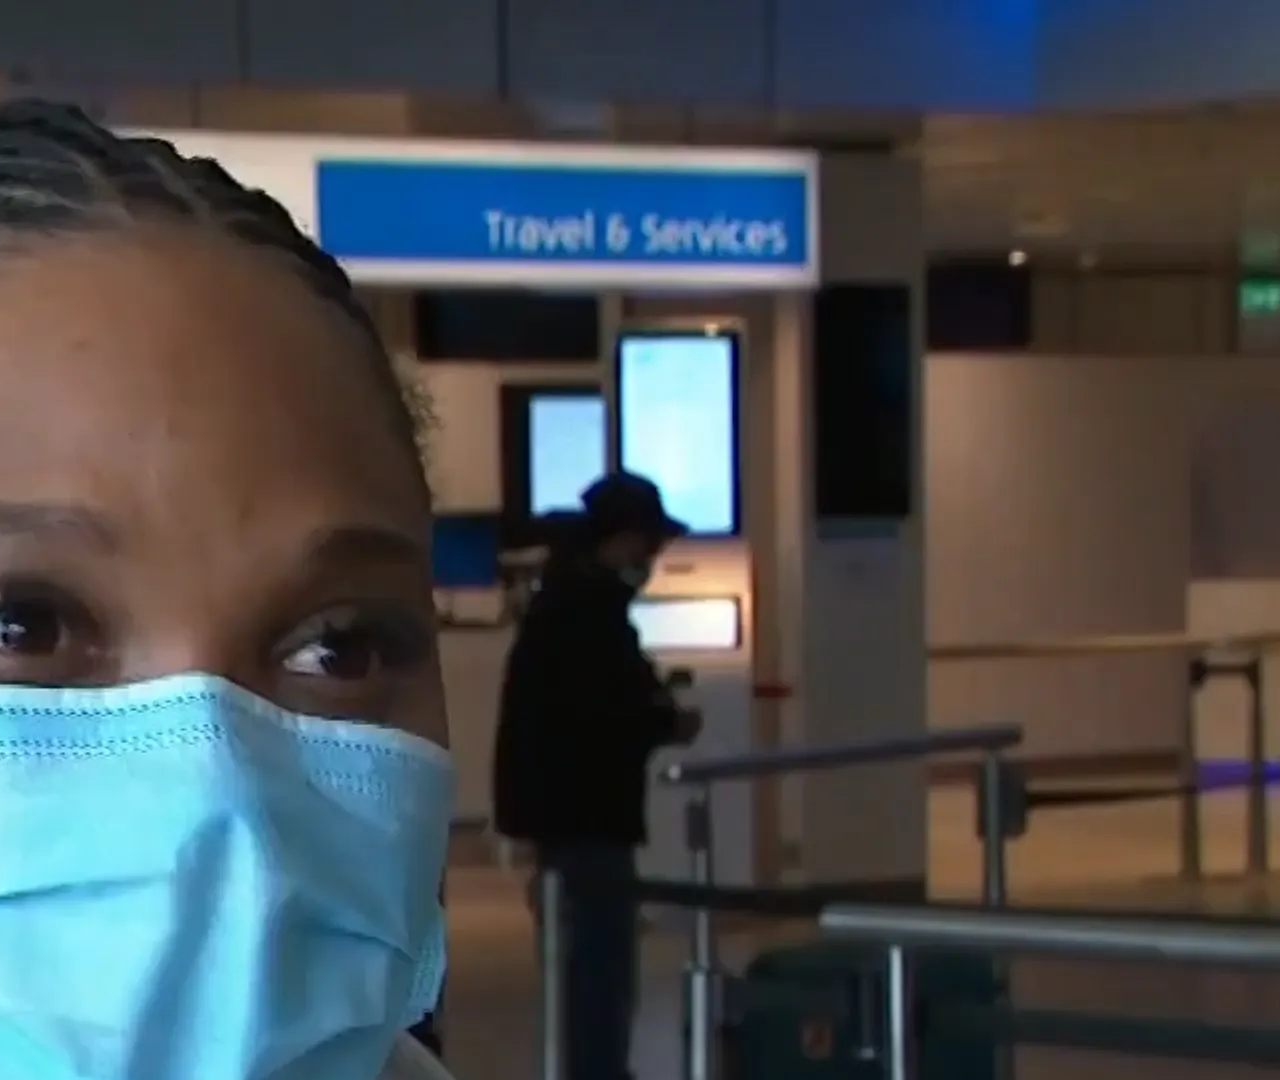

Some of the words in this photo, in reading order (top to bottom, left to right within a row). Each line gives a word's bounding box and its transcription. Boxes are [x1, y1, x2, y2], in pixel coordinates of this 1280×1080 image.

[484, 209, 594, 252] Travel
[606, 212, 630, 252] &
[641, 211, 787, 255] Services
